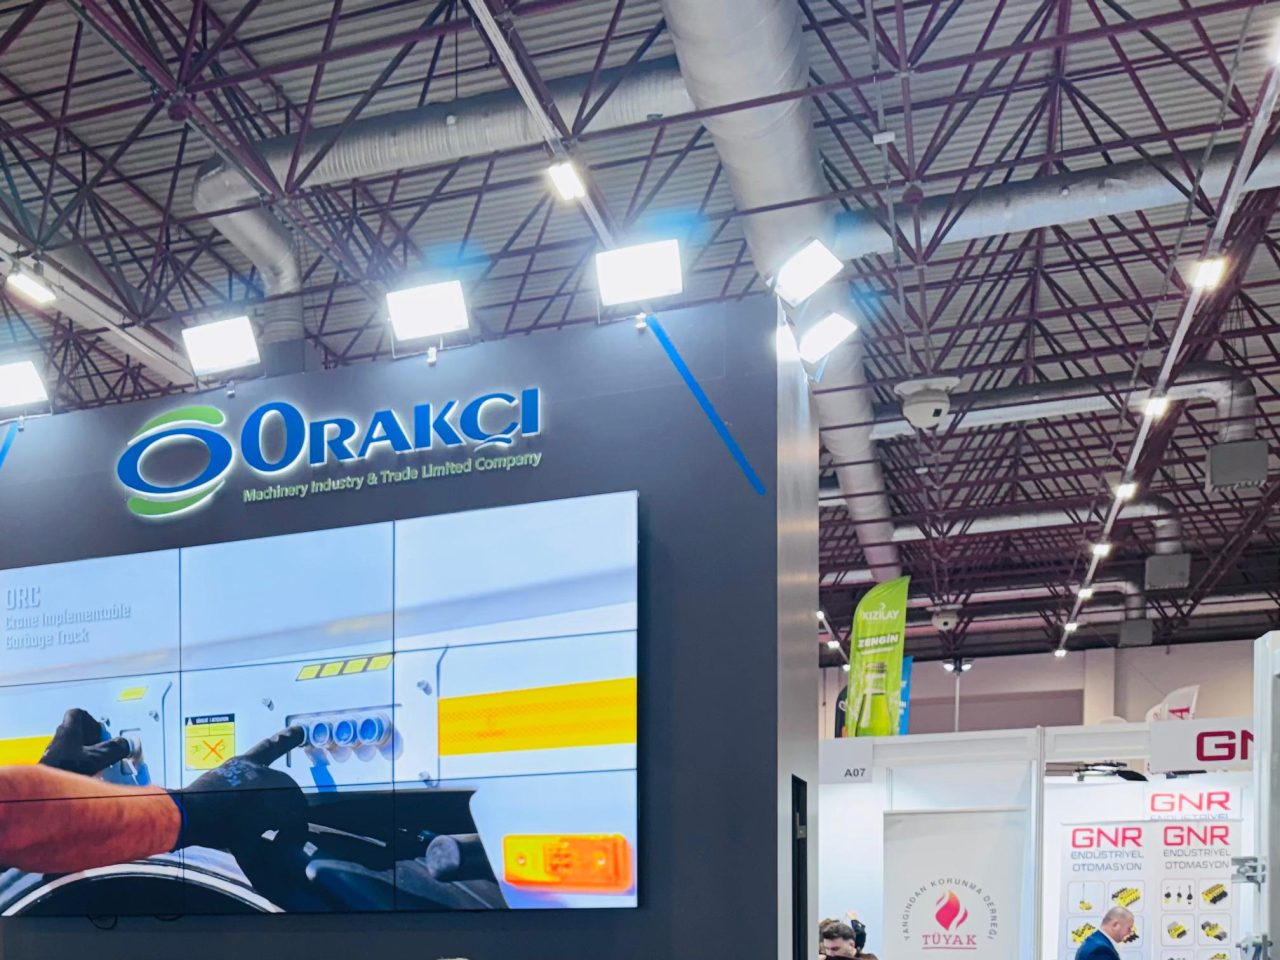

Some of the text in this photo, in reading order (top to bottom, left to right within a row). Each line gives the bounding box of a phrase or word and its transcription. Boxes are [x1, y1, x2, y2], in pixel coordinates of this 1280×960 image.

[240, 387, 542, 474] ORAKÇI
[243, 450, 543, 503] Machinery Industry & Trade Limited Company
[844, 767, 867, 779] A07
[1150, 791, 1231, 813] GNR
[1072, 827, 1144, 849] GNR
[1163, 825, 1231, 847] GNR
[1070, 848, 1145, 860] ENDÜSTRİYEL
[1163, 846, 1232, 858] ENDÜSTRİYEL
[1072, 862, 1143, 873] OTOMASYON
[1165, 860, 1231, 871] OTOMASYON
[922, 932, 977, 946] TÜYAK
